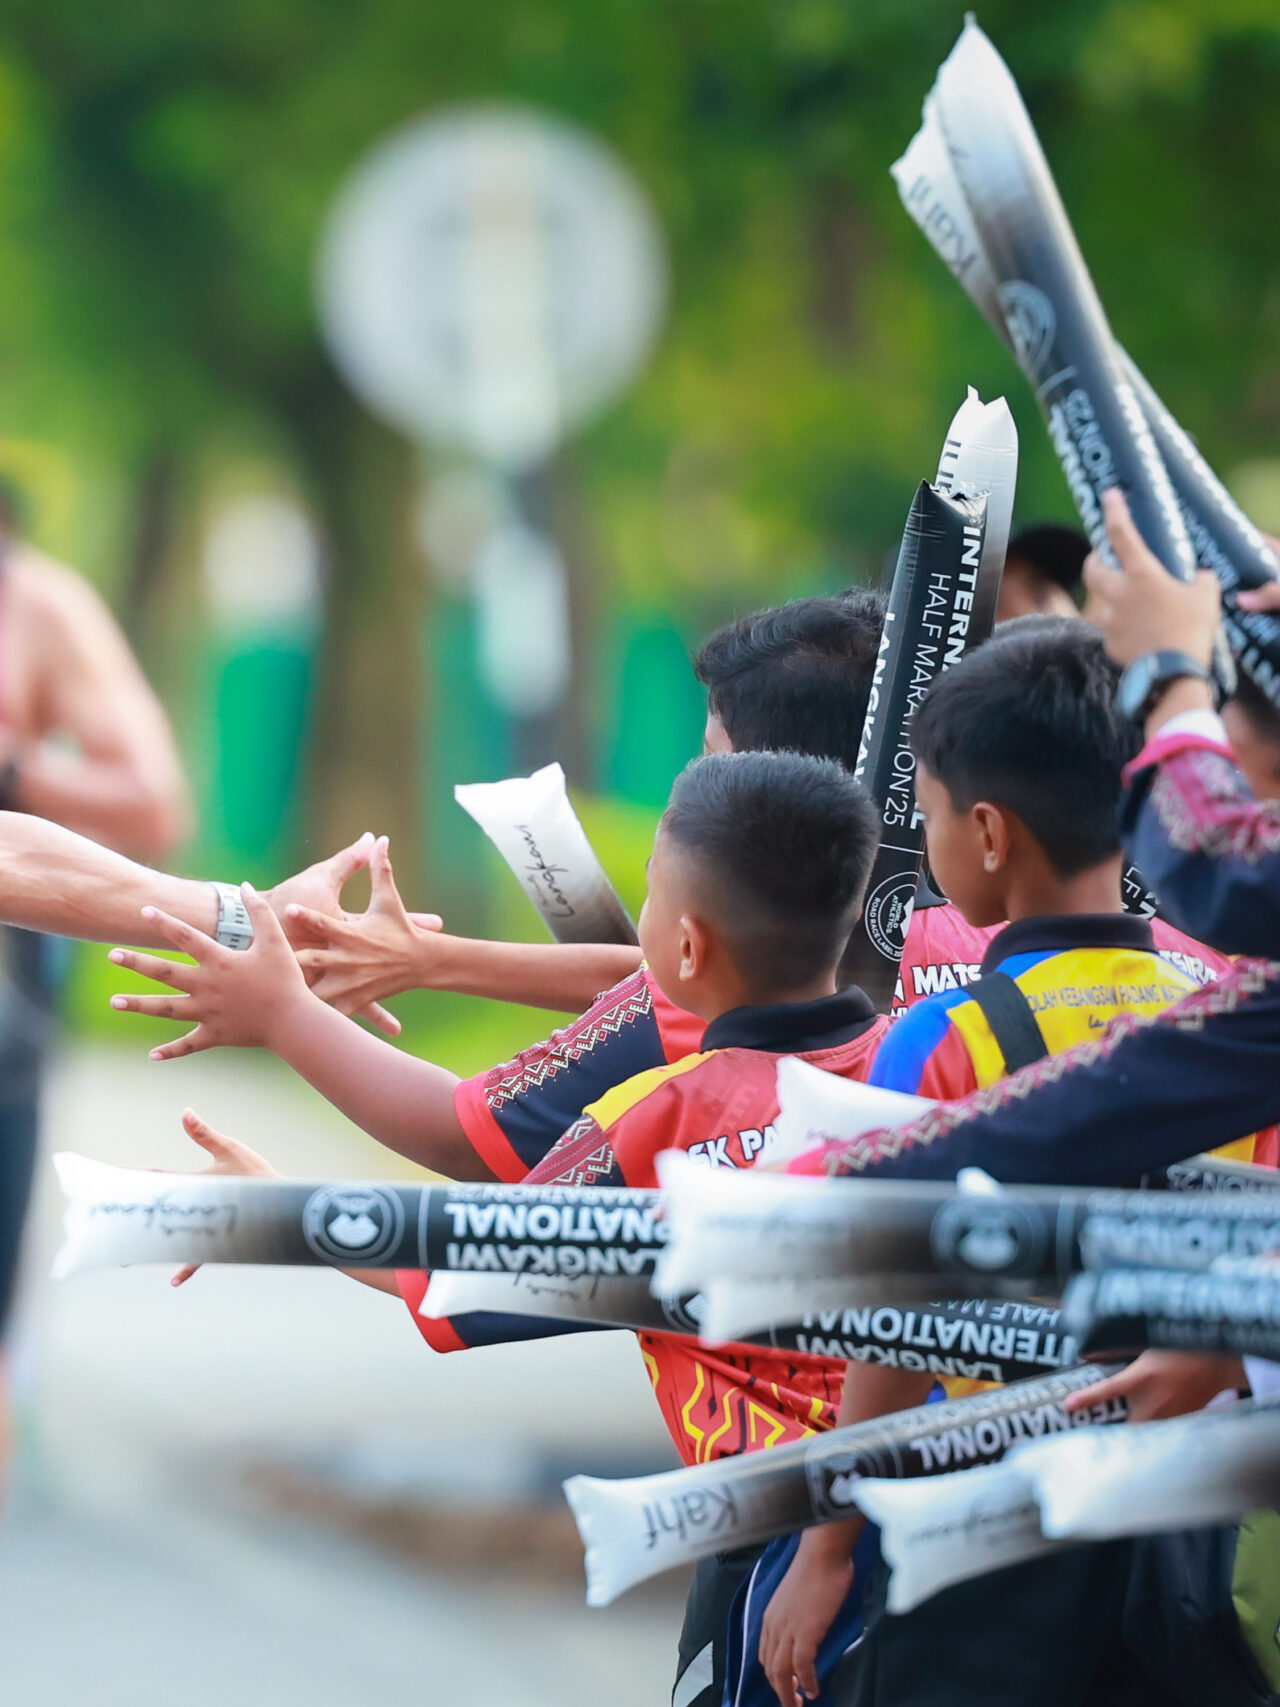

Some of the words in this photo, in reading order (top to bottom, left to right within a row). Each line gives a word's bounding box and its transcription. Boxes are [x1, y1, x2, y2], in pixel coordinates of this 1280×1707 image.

[920, 572, 952, 639] HALF
[869, 897, 881, 918] ROAD
[885, 894, 899, 934] ATHLETICS
[892, 902, 903, 928] WORLD
[870, 918, 881, 939] RACE
[876, 937, 894, 956] LABEL
[911, 964, 983, 997] MATS
[687, 1135, 738, 1171] SK
[446, 1242, 663, 1276] LANGKAWI
[990, 1301, 1061, 1328] HALF
[641, 1481, 740, 1549] Kahf
